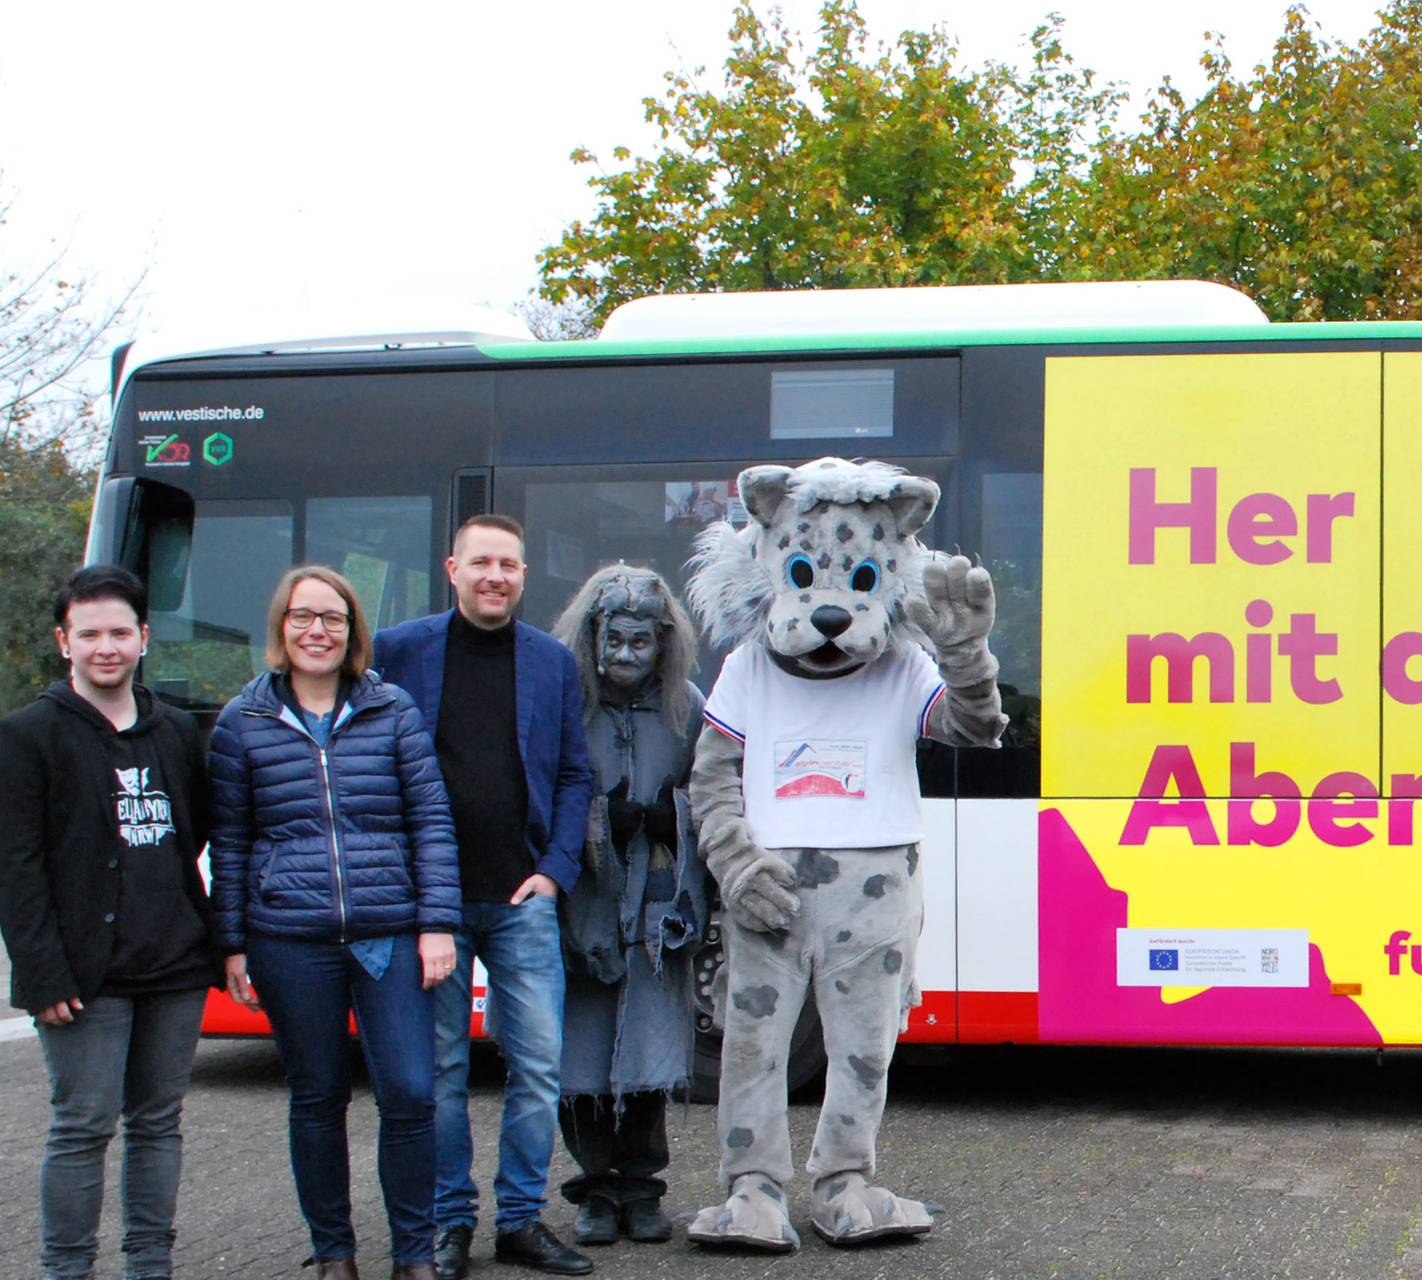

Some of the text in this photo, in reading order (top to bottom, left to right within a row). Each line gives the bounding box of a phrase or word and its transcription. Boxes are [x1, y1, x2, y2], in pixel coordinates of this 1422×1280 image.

[138, 405, 264, 421] www.vestische.de
[1128, 466, 1355, 565] Her
[1126, 599, 1344, 705] mit
